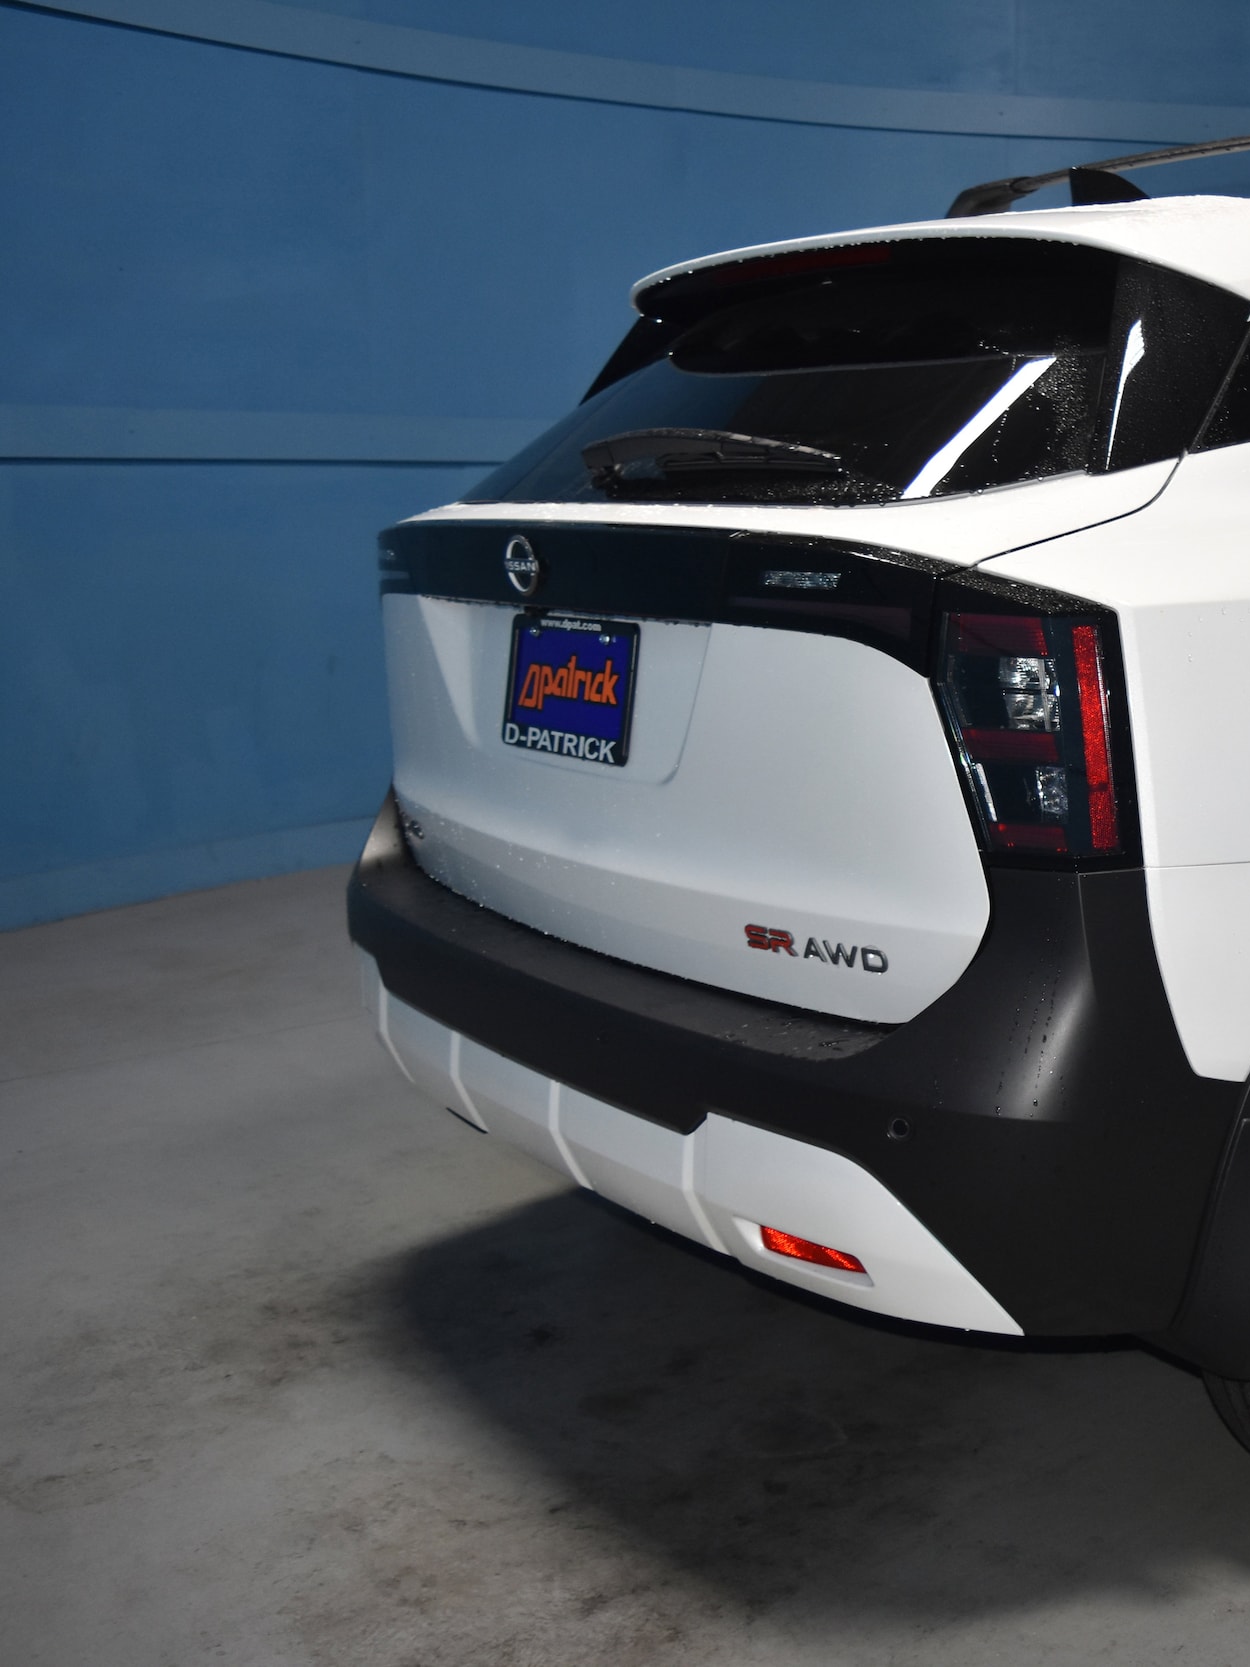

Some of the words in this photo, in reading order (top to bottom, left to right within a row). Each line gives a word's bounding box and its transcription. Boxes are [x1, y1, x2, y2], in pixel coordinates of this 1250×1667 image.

[504, 560, 537, 571] SSAN
[540, 619, 602, 632] www.dpat.com
[504, 722, 616, 763] D-PATRICK
[744, 924, 798, 957] SR
[803, 937, 889, 974] AWD
